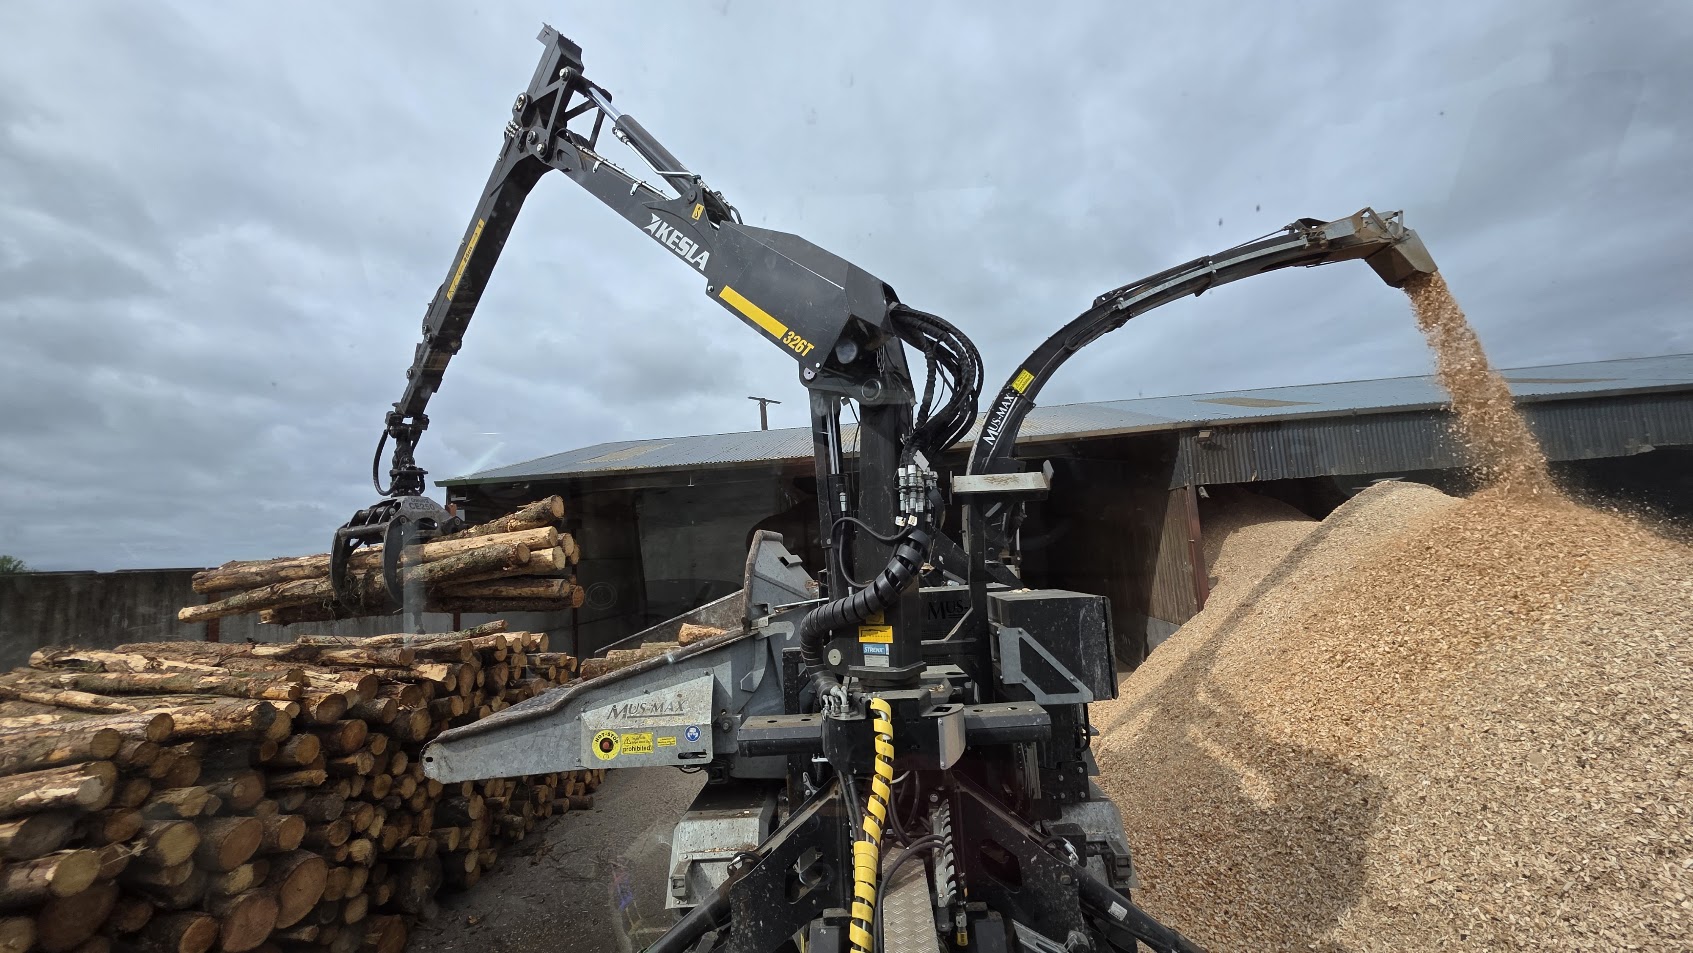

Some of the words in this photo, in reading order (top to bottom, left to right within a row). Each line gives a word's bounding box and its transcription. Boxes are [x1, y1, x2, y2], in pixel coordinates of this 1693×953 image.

[655, 221, 710, 271] KESLA
[783, 331, 814, 357] 326T
[983, 394, 1014, 445] MUS-MAX
[409, 502, 435, 510] CE250
[928, 600, 968, 620] MUS-
[608, 701, 685, 720] MUS-MAX
